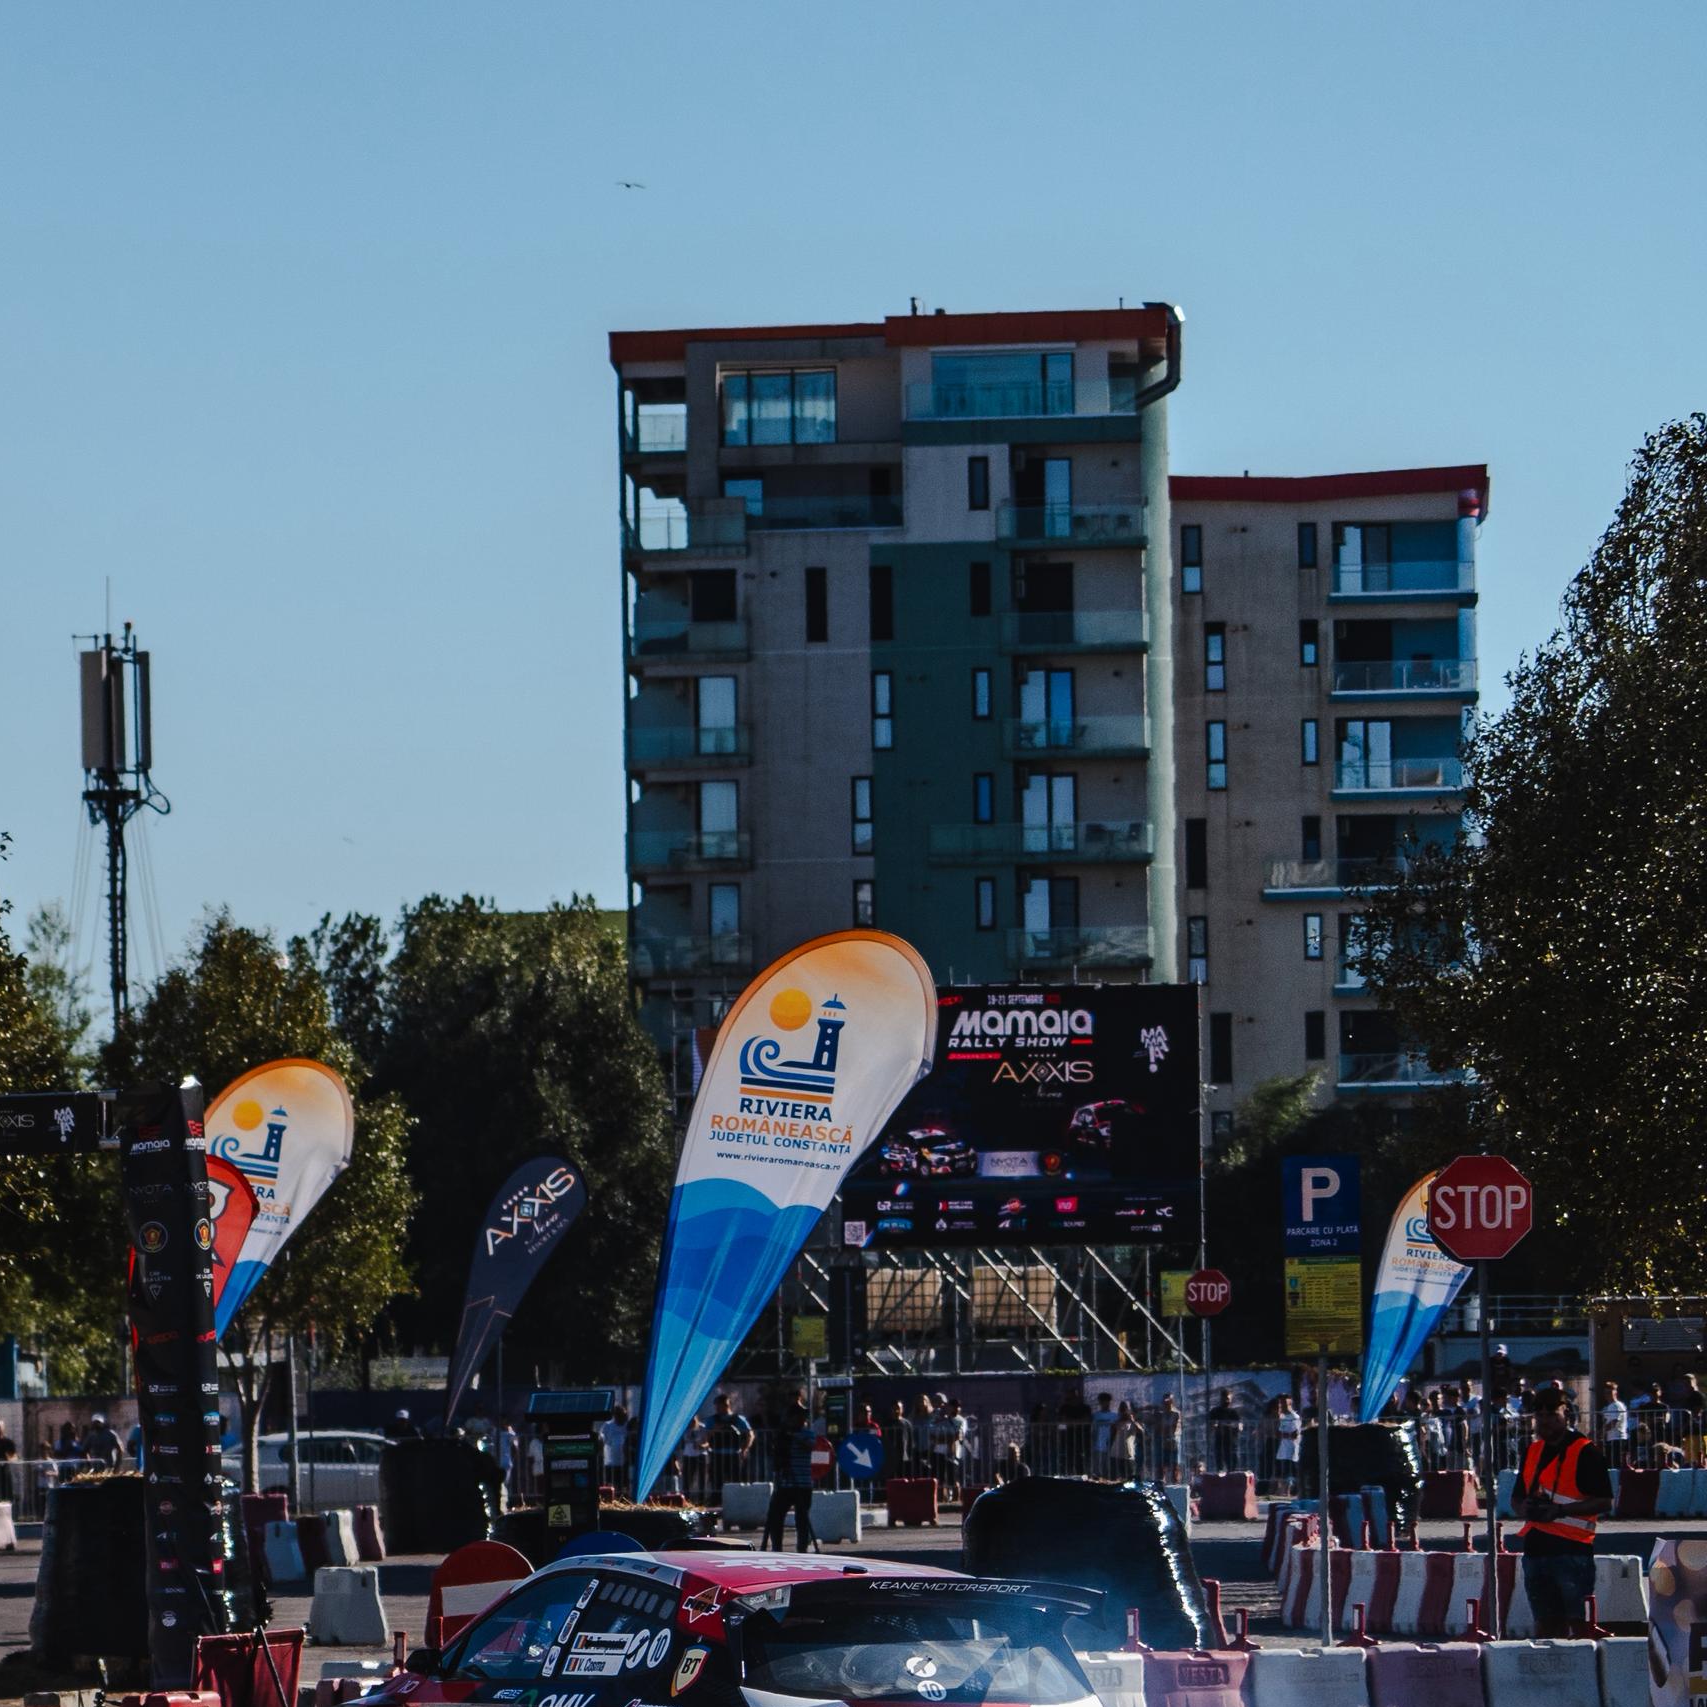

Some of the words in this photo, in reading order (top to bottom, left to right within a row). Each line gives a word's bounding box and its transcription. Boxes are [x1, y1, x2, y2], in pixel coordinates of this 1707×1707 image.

[948, 1037, 1006, 1048] RALLY
[1015, 1037, 1067, 1048] SHOW
[992, 1061, 1094, 1083] AXXIS
[739, 1097, 833, 1123] RIVIERA
[710, 1114, 853, 1144] ROMÂNEASCĂ
[1301, 1167, 1341, 1222] P
[487, 1167, 575, 1255] AXXIS
[1435, 1185, 1527, 1230] STOP
[1286, 1227, 1320, 1236] PARCARE
[1323, 1227, 1333, 1235] CU
[1310, 1239, 1331, 1247] ZONA
[1188, 1282, 1227, 1302] STOP
[650, 1634, 668, 1662] 10
[681, 1658, 701, 1675] BT
[1180, 1667, 1226, 1687] VESTA
[922, 1682, 943, 1698] 10
